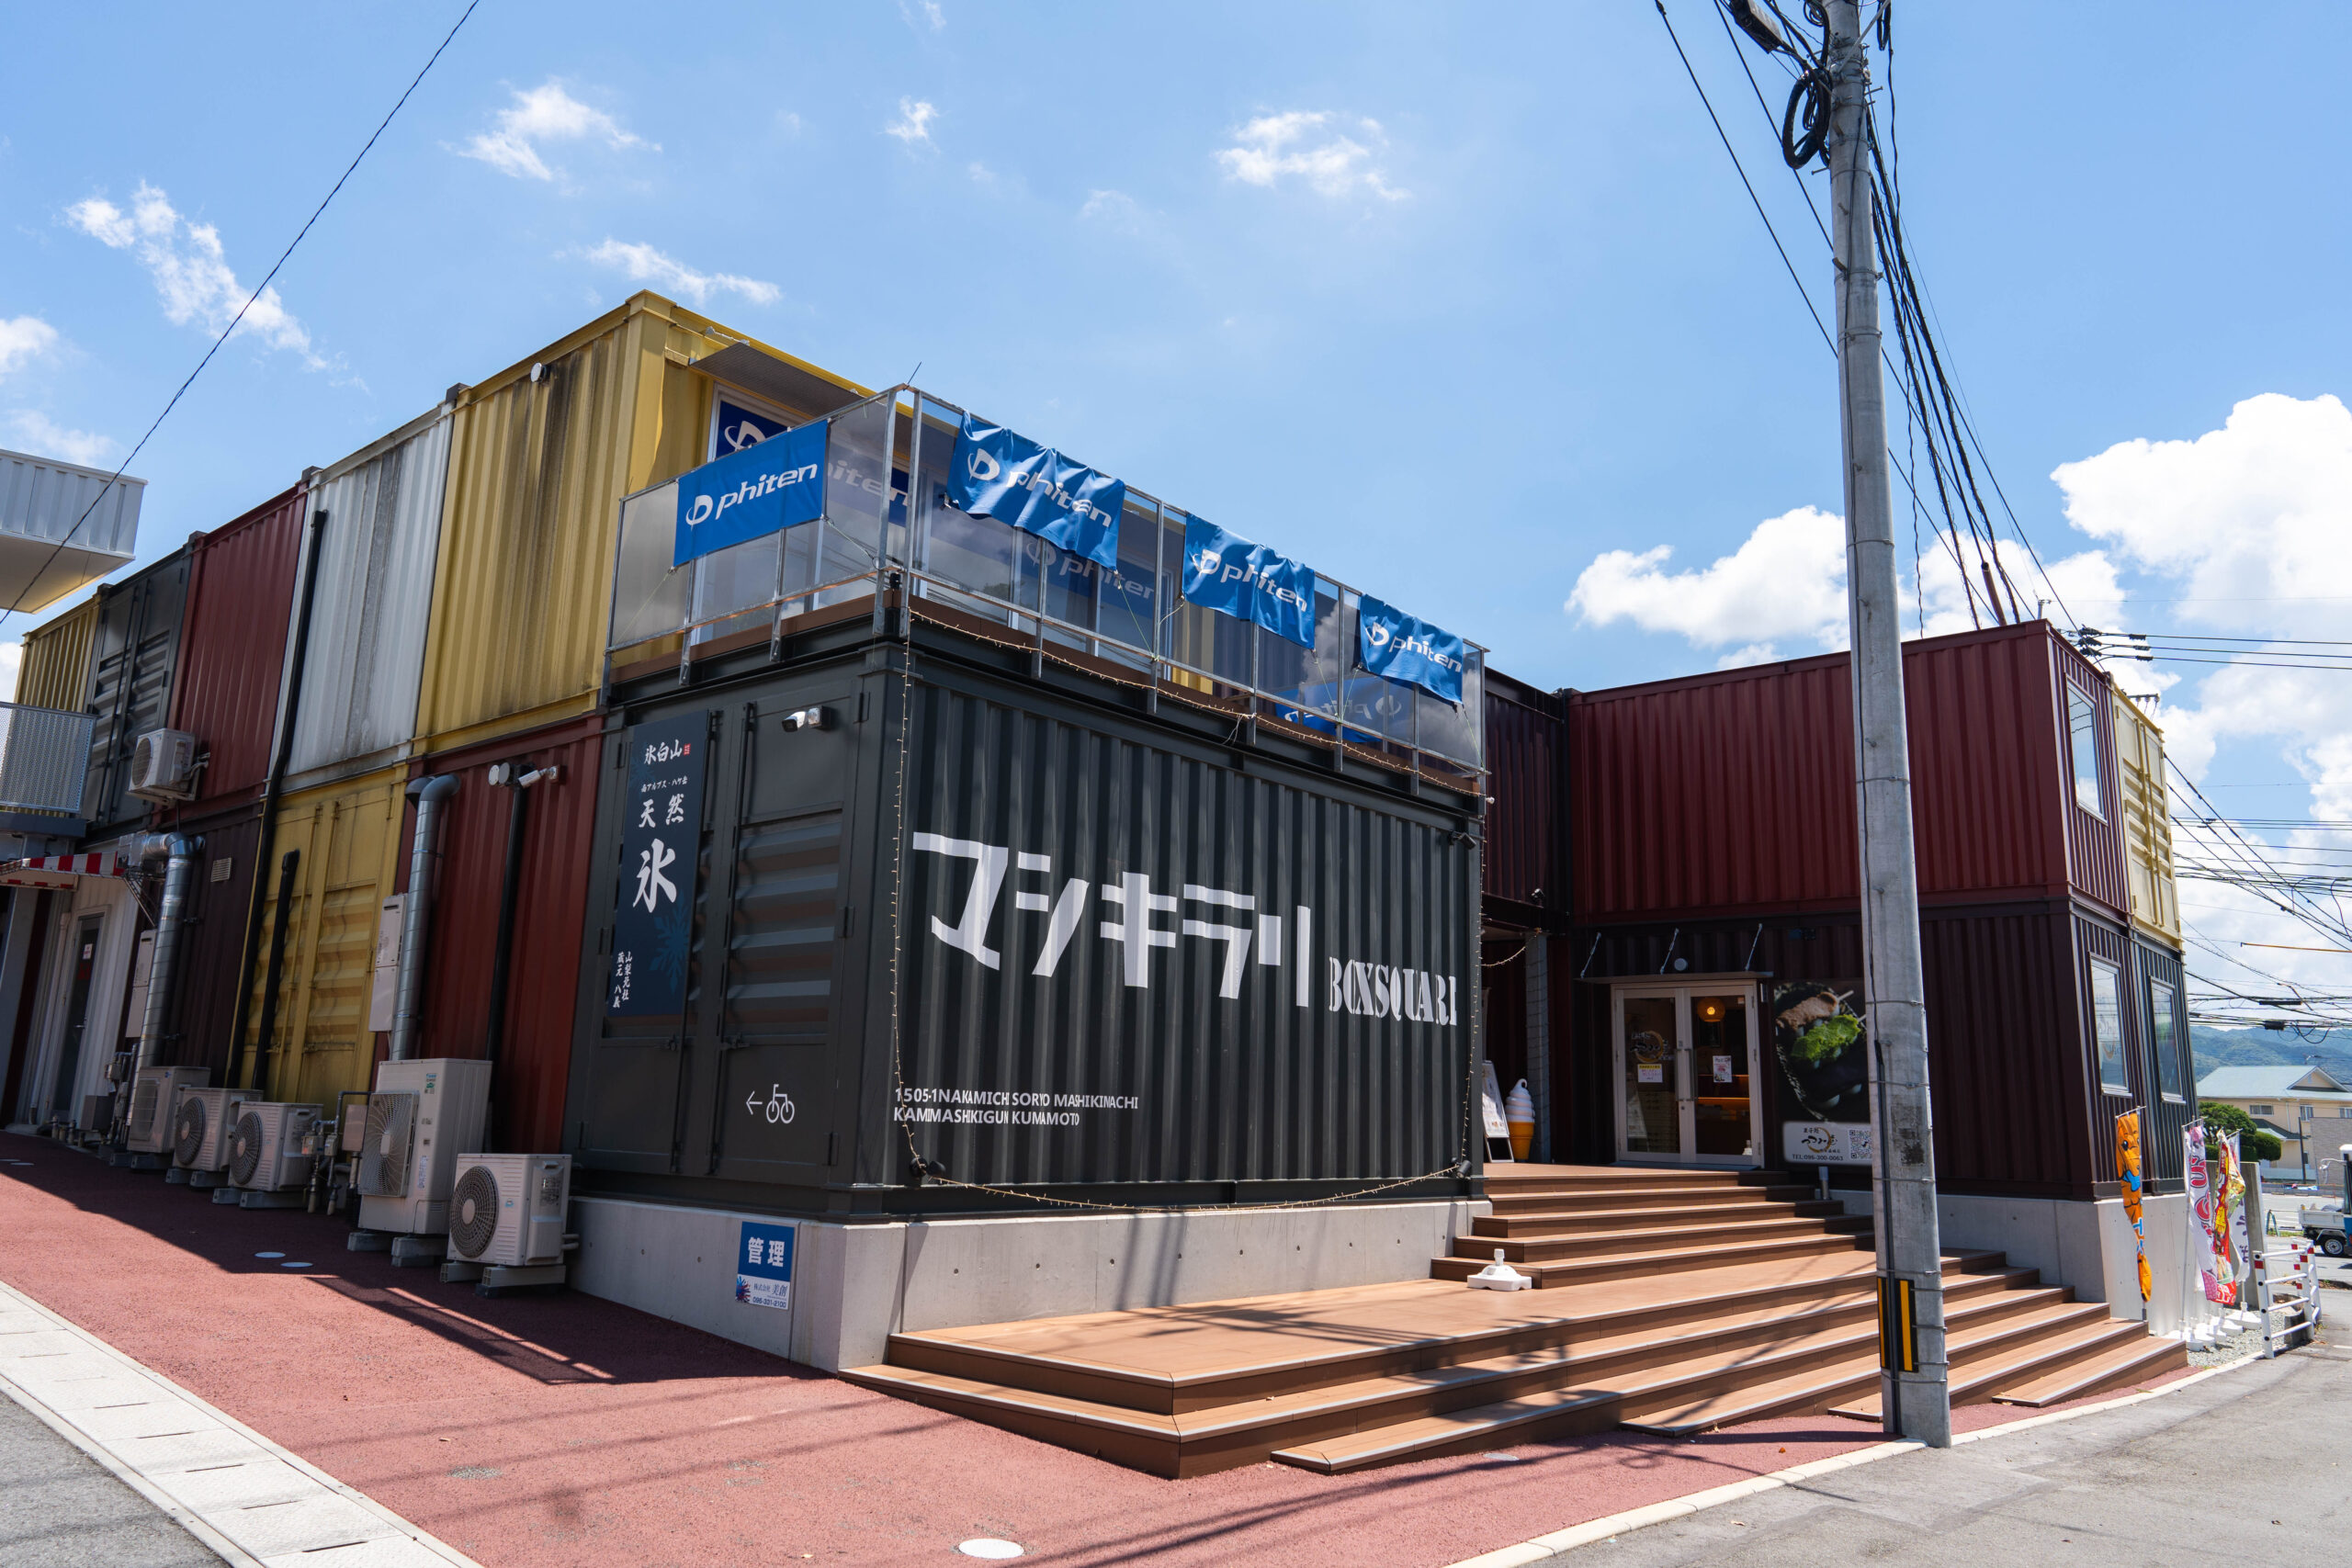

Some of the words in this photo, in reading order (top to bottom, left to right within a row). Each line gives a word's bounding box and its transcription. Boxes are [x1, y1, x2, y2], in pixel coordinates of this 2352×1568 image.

[715, 463, 818, 520] phiten
[1006, 470, 1113, 527] phiten
[1220, 563, 1307, 613] phiten
[1388, 635, 1462, 673] phiten
[632, 838, 677, 913] 氷
[912, 831, 1311, 1008] マシキラリ
[1012, 1092, 1050, 1107] SORYO
[1012, 1111, 1080, 1126] KUMAMOTO
[747, 1235, 786, 1268] 管理
